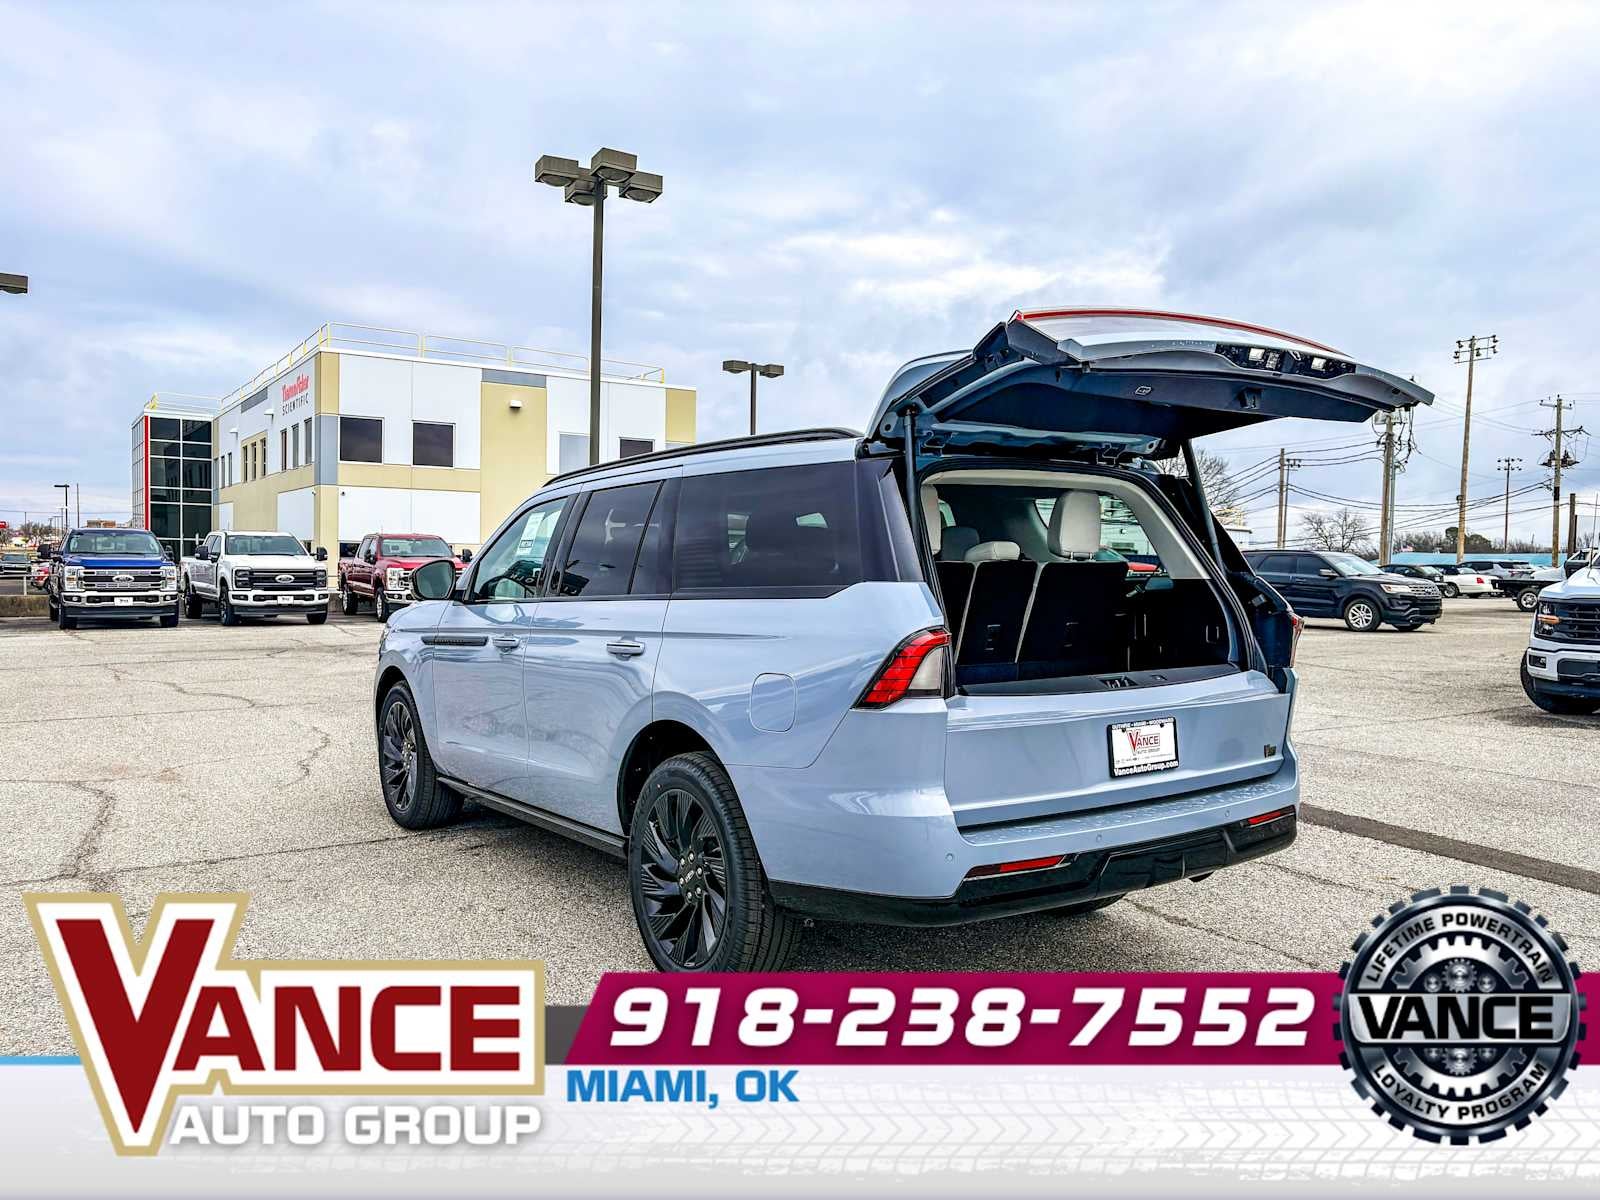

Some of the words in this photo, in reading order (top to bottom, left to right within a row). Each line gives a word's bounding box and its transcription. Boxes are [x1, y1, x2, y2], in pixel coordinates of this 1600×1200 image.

[282, 392, 309, 416] SCIENTIFIC
[1129, 731, 1159, 752] VANCE
[1113, 760, 1178, 776] VanceAutoGroup.com
